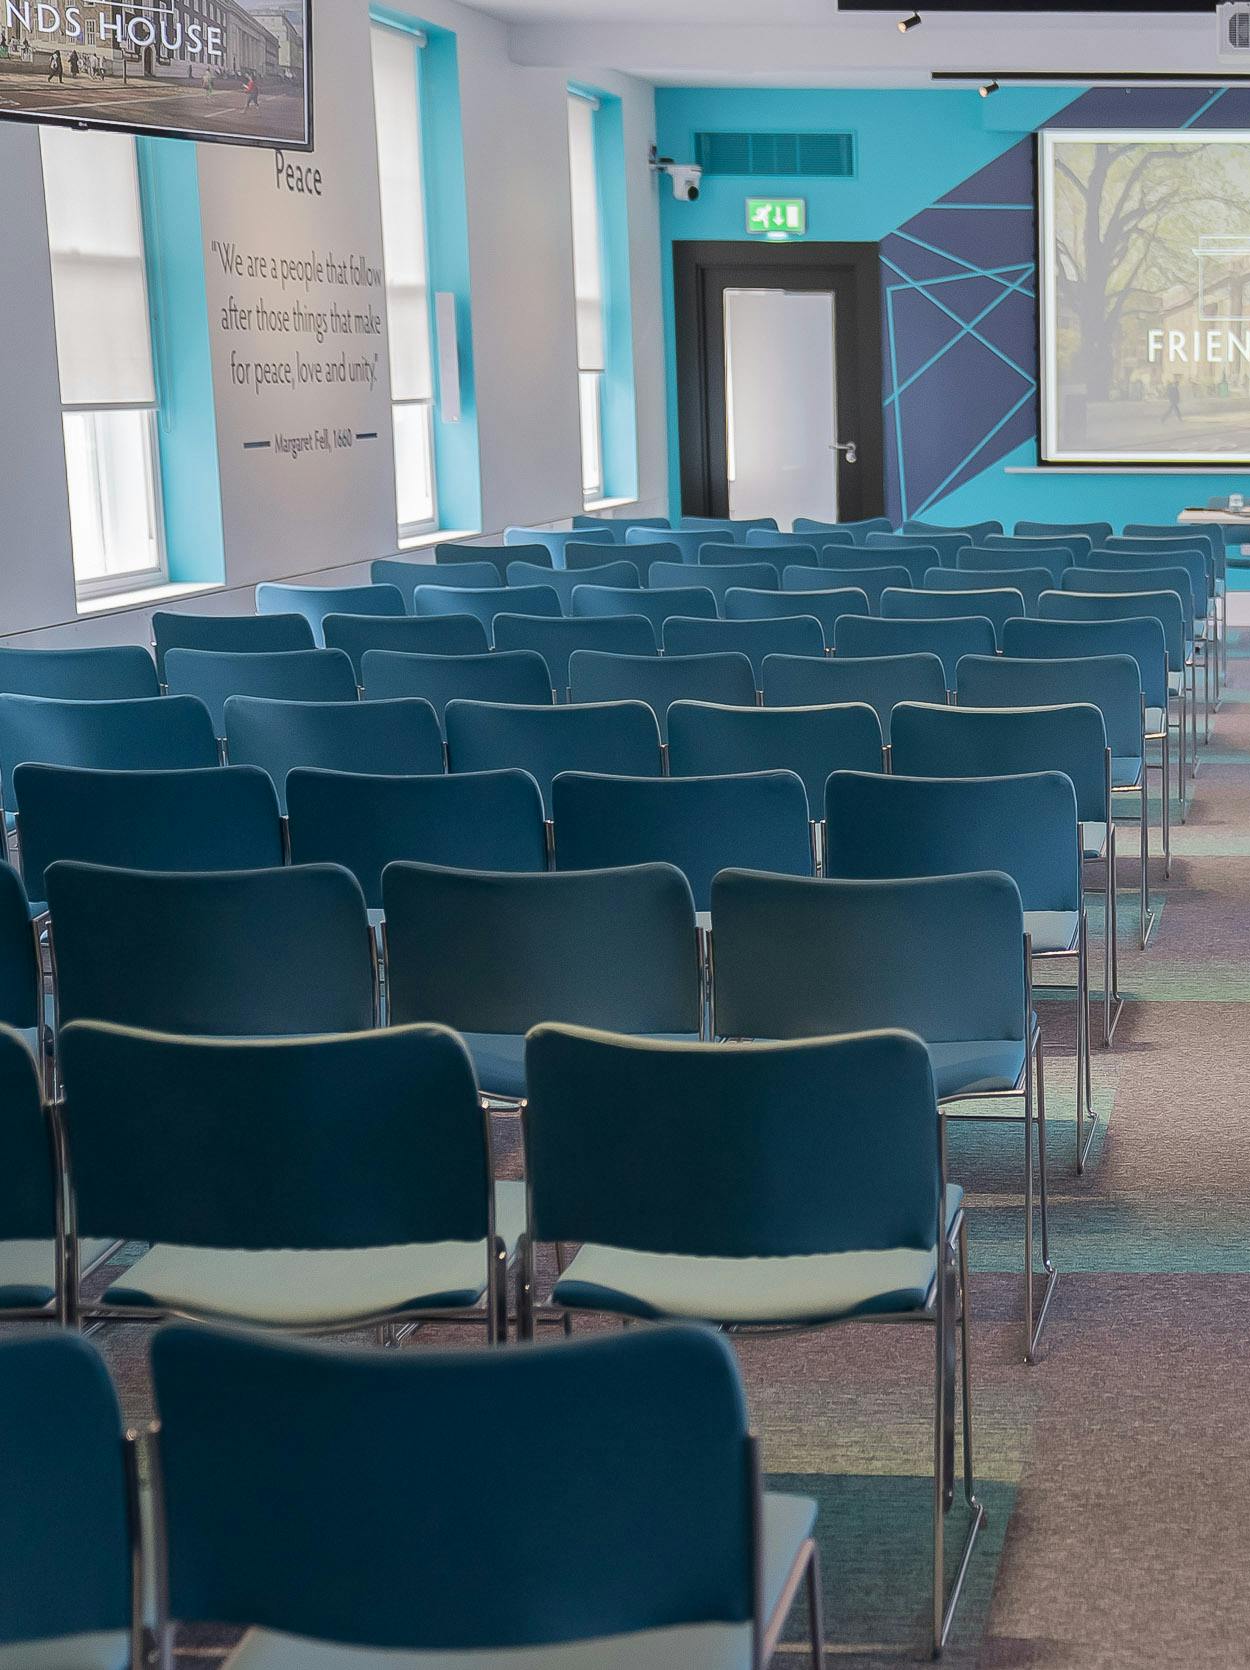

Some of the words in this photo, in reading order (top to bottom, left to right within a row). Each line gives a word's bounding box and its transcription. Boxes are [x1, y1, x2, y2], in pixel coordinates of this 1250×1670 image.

[99, 12, 222, 56] HOUSE
[275, 149, 322, 196] Peace
[211, 240, 243, 276] "We
[247, 255, 267, 279] are
[270, 257, 278, 279] a
[280, 250, 323, 292] people
[326, 252, 348, 285] that
[349, 254, 382, 287] follow
[221, 295, 252, 330] after
[256, 297, 290, 332] those
[293, 300, 327, 343] things
[330, 302, 352, 334] that
[354, 304, 381, 335] make
[231, 350, 251, 385] for
[254, 358, 296, 395] peace,
[296, 351, 322, 383] love
[325, 352, 346, 382] and
[274, 432, 313, 459] Margaret
[314, 428, 333, 453] Fell,
[333, 428, 353, 449] 1660
